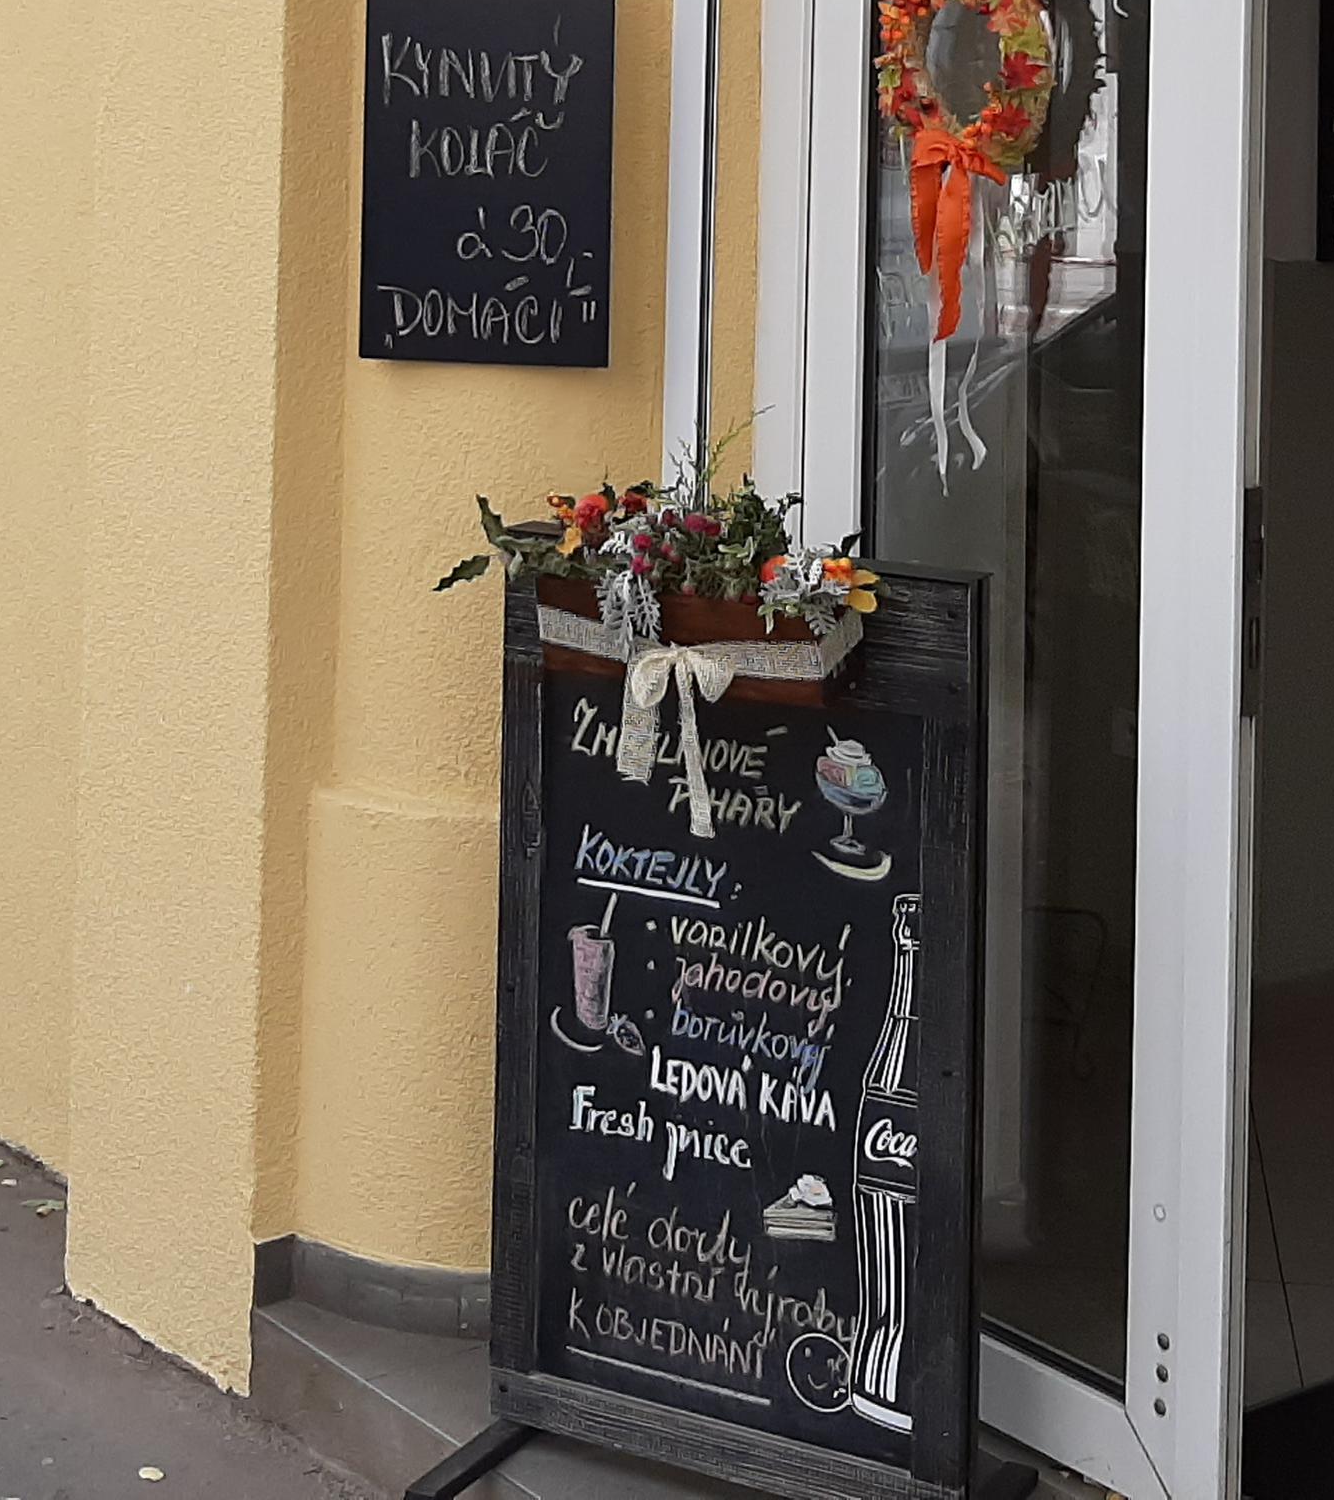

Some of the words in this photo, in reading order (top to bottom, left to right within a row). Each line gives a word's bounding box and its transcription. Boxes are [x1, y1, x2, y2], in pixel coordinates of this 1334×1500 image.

[409, 108, 565, 179] KOLÁČ
[668, 775, 803, 835] PHÁRY
[569, 1085, 655, 1142] Fresh
[650, 1045, 752, 1111] LEDOVÁ
[758, 1066, 836, 1132] KÁVA
[864, 1117, 918, 1170] Coca
